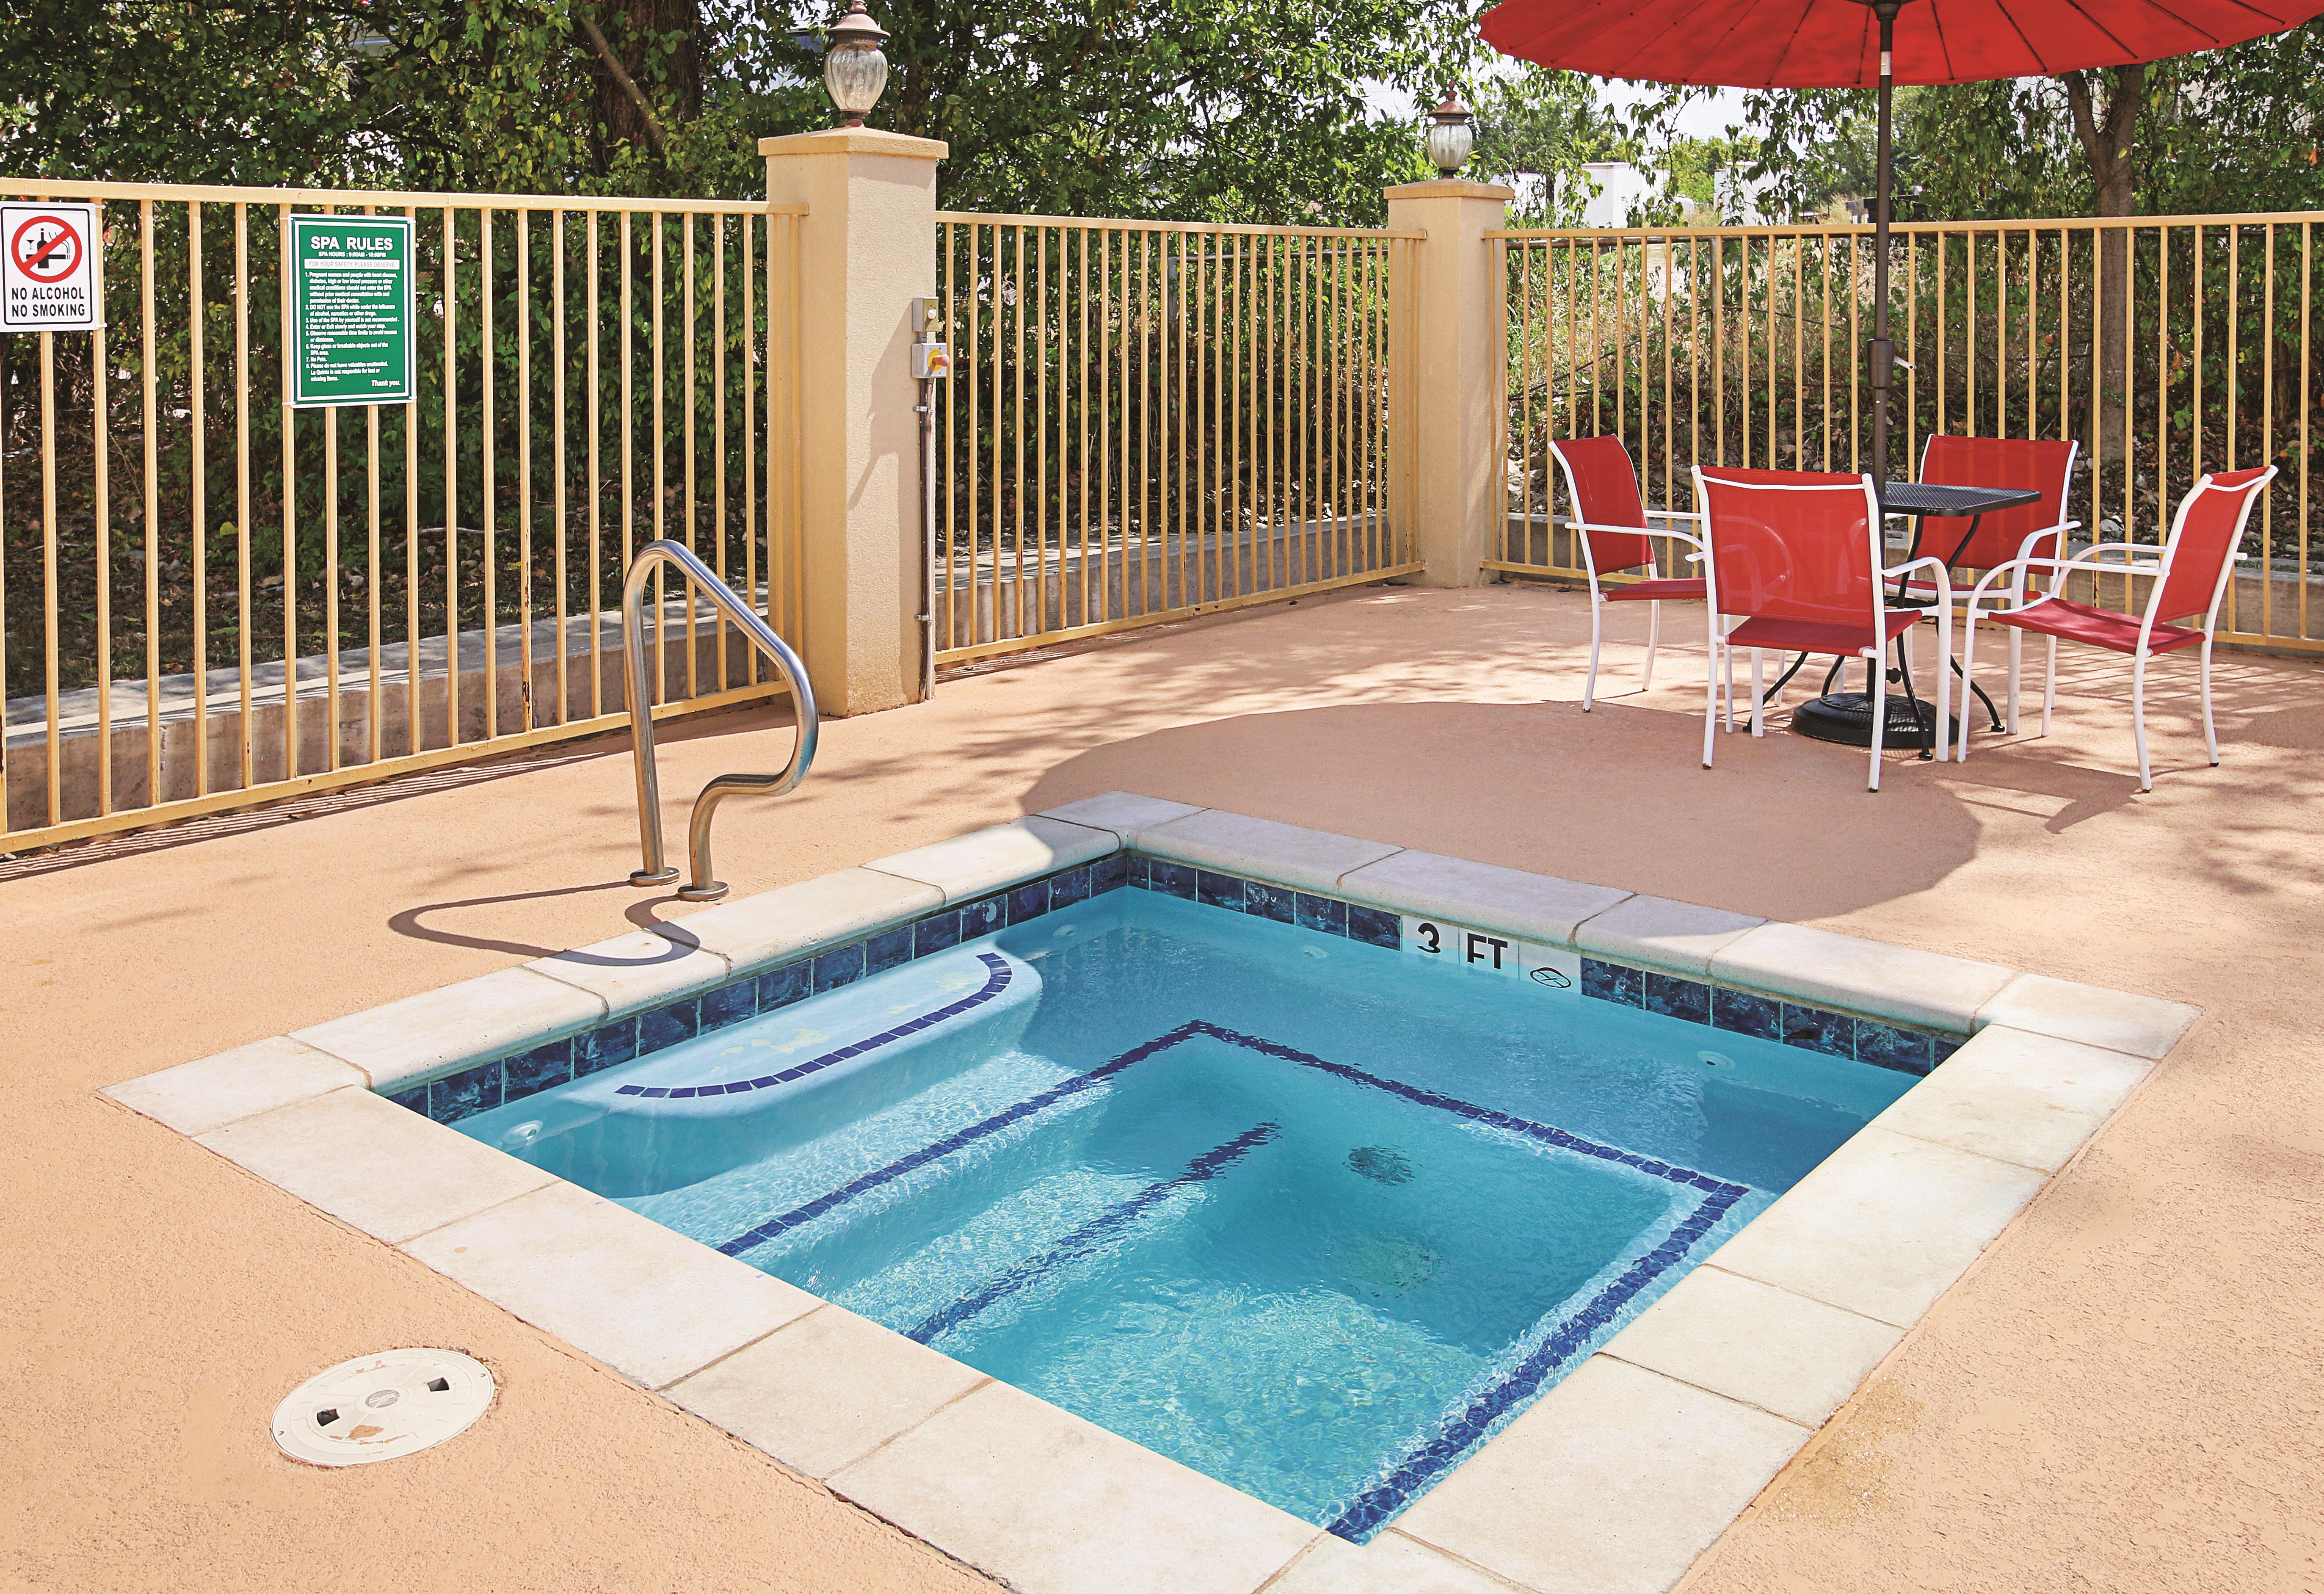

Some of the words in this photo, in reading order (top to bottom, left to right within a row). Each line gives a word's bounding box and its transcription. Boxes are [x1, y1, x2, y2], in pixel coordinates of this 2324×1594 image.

[311, 236, 340, 250] SPA
[347, 237, 393, 251] RULES
[12, 287, 28, 300] NO
[32, 287, 85, 300] ALCOHOL
[12, 304, 28, 317] NO
[33, 304, 85, 317] SMOKING
[1417, 922, 1441, 953] 3
[1467, 932, 1508, 970] FT
